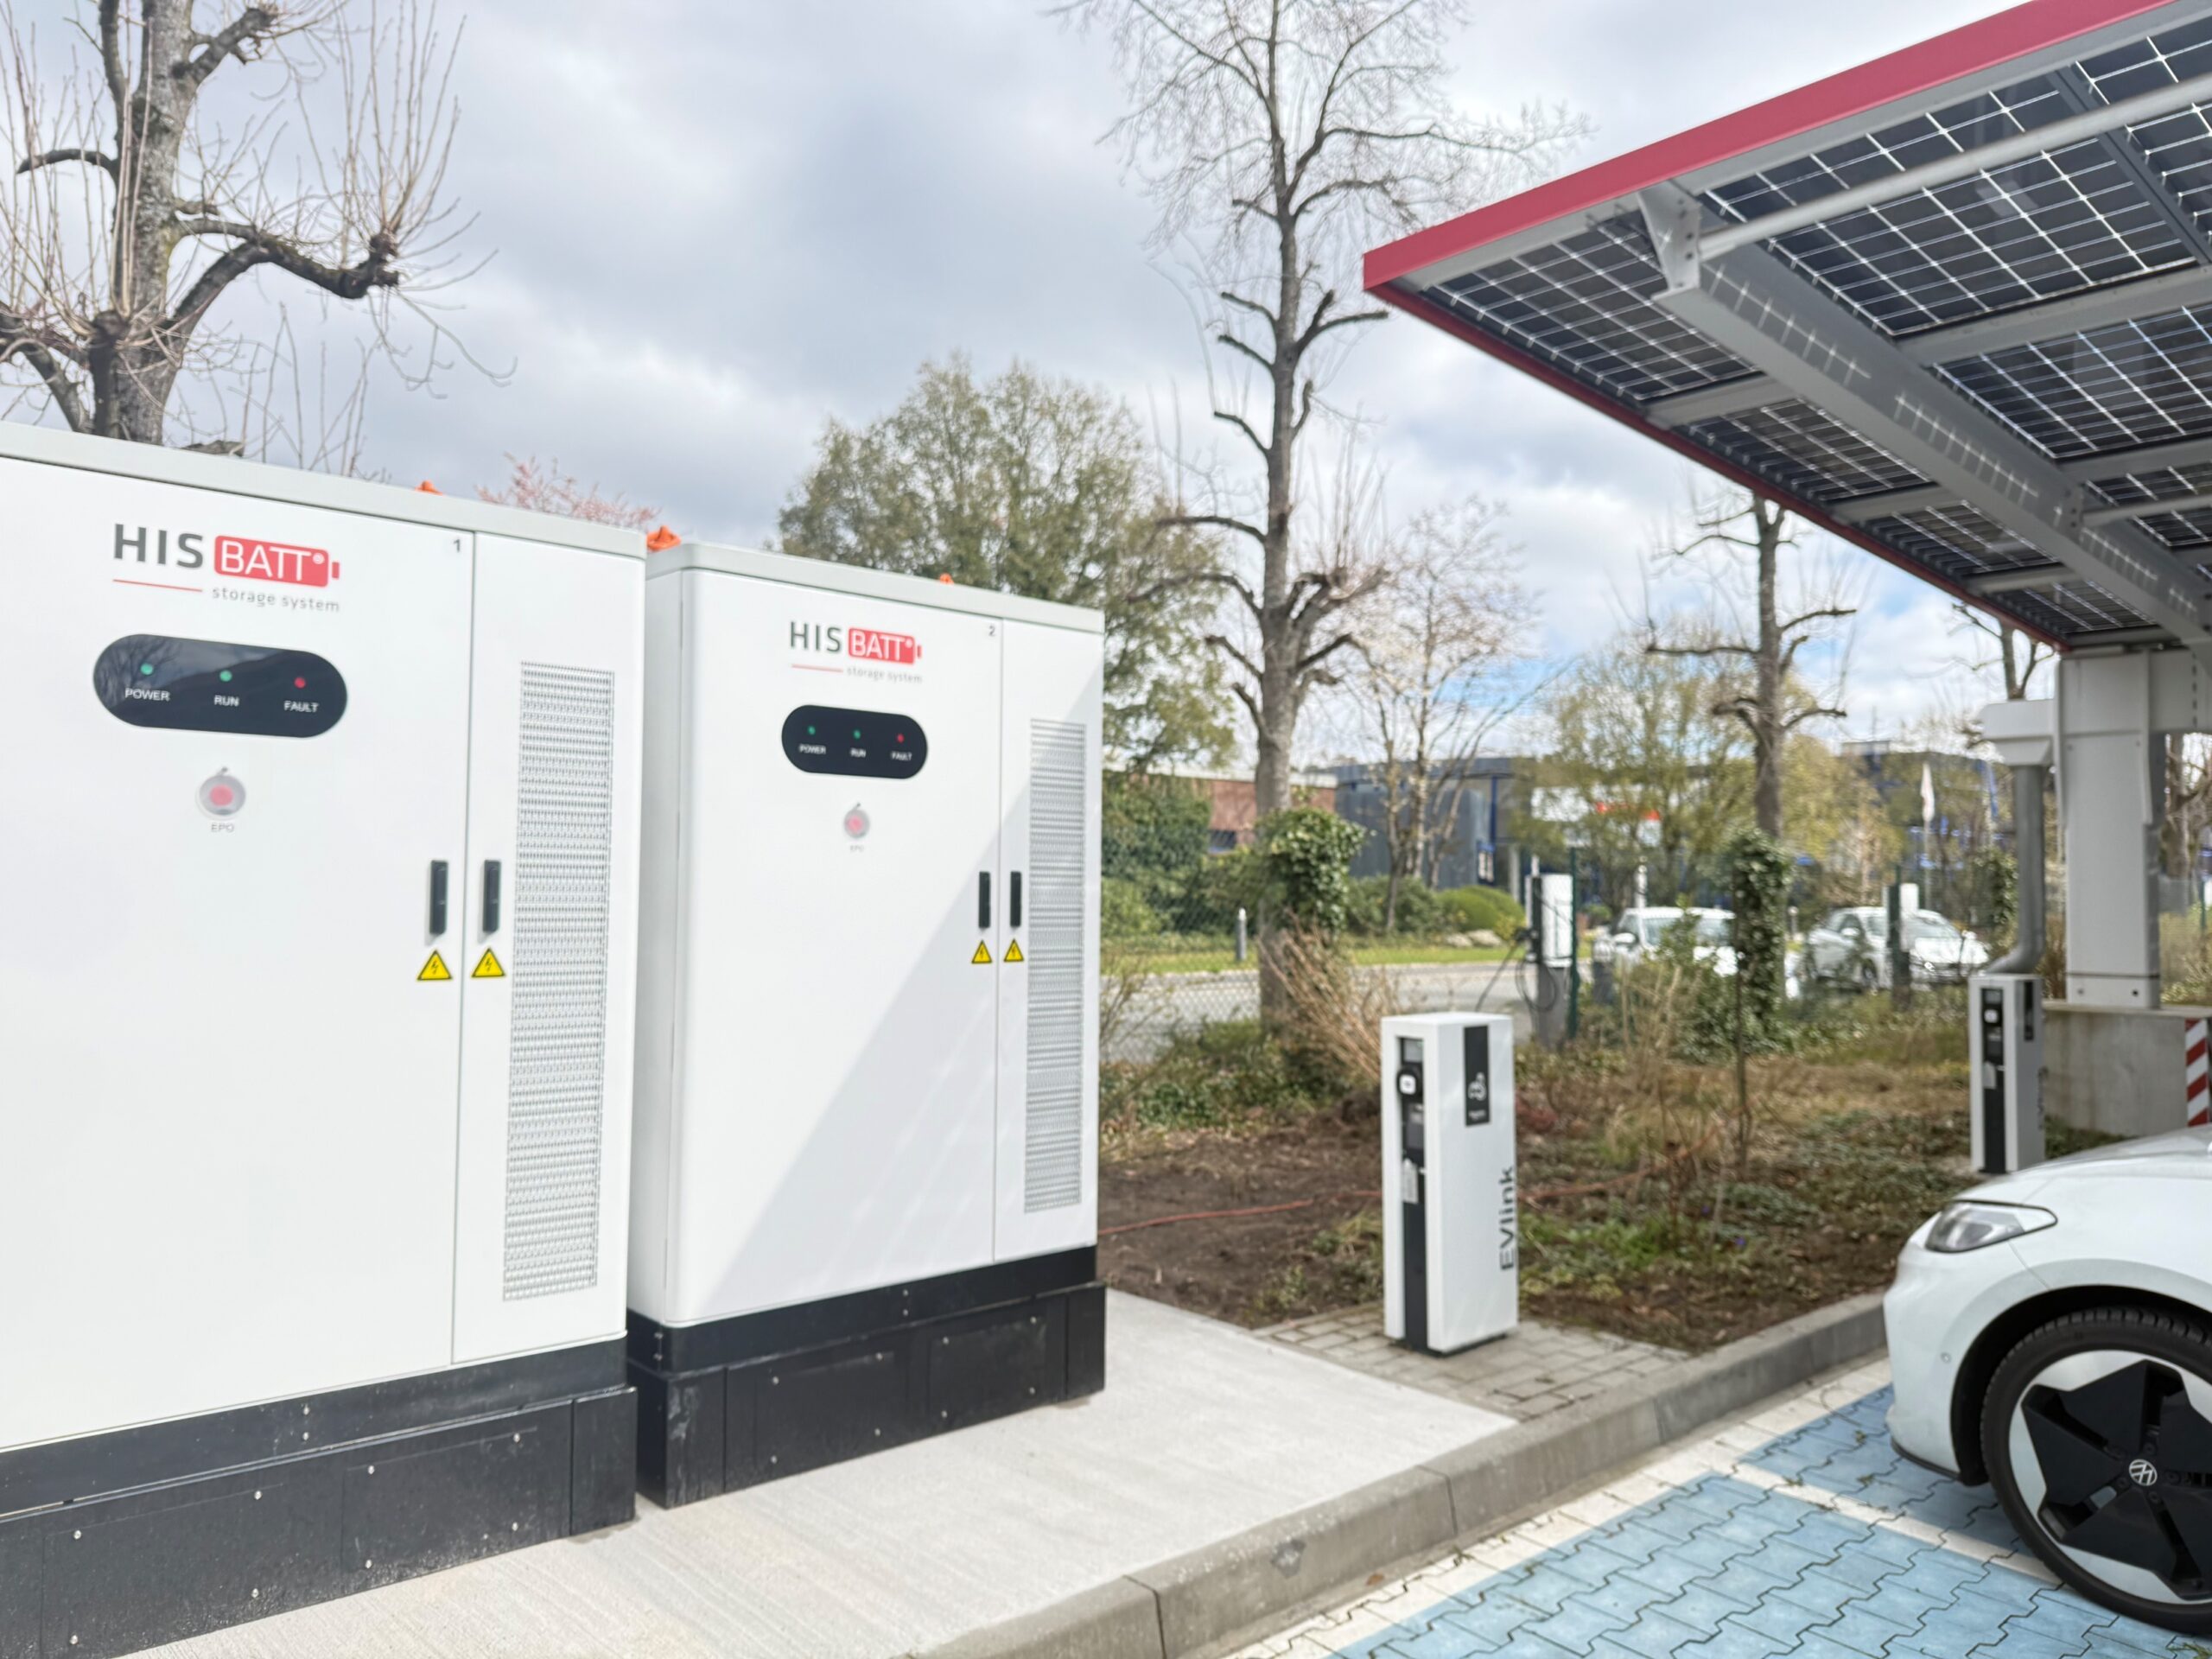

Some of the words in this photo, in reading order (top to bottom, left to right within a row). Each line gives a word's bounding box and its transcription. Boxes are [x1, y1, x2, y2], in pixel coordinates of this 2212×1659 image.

[453, 538, 461, 552] 1
[212, 587, 276, 608] storage
[281, 594, 340, 613] system
[846, 665, 885, 681] storage
[887, 671, 924, 684] system
[124, 687, 171, 702] POWER
[213, 694, 240, 708] RUN
[283, 699, 320, 714] FAULT
[798, 743, 827, 755] POWER
[850, 747, 867, 759] RUN
[890, 750, 913, 761] FAULT
[210, 822, 235, 834] EPO
[1498, 1166, 1515, 1271] EVlink
